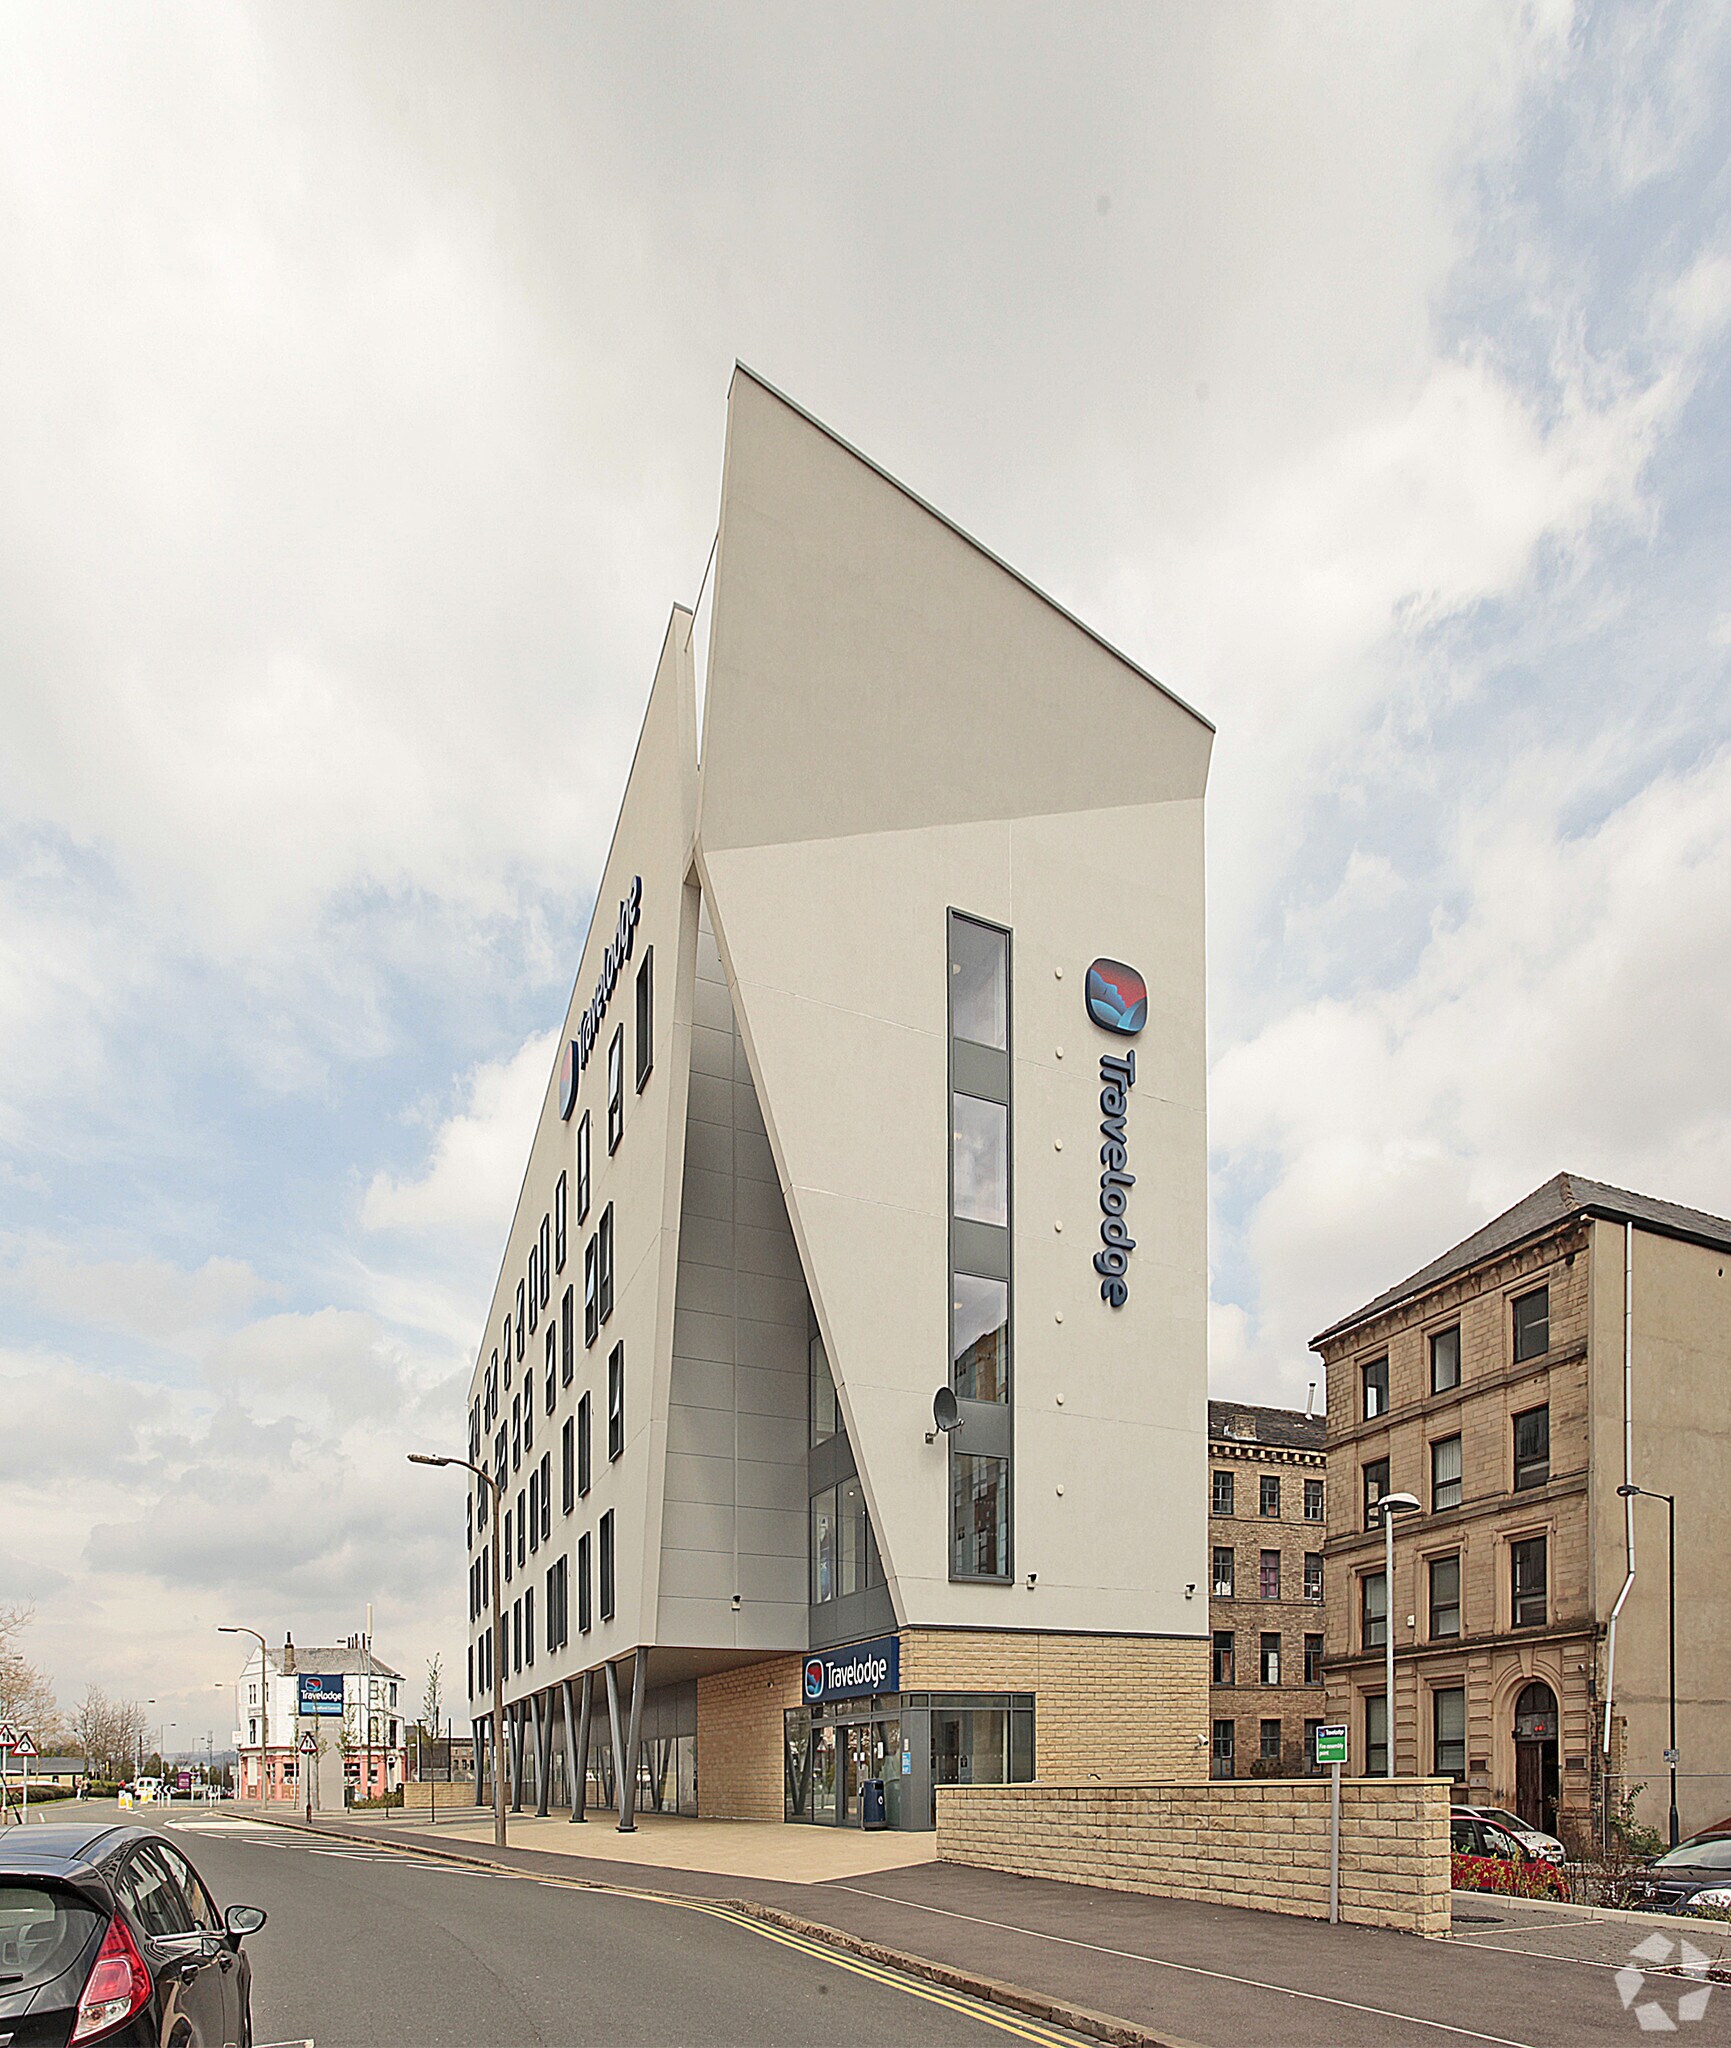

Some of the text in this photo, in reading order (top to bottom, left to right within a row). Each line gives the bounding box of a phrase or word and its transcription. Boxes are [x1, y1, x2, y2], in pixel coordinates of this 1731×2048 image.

[577, 874, 643, 1071] Travelodge
[1093, 1049, 1137, 1309] Travelodge
[301, 1689, 343, 1702] Travelodge
[825, 1653, 887, 1690] Travelodge
